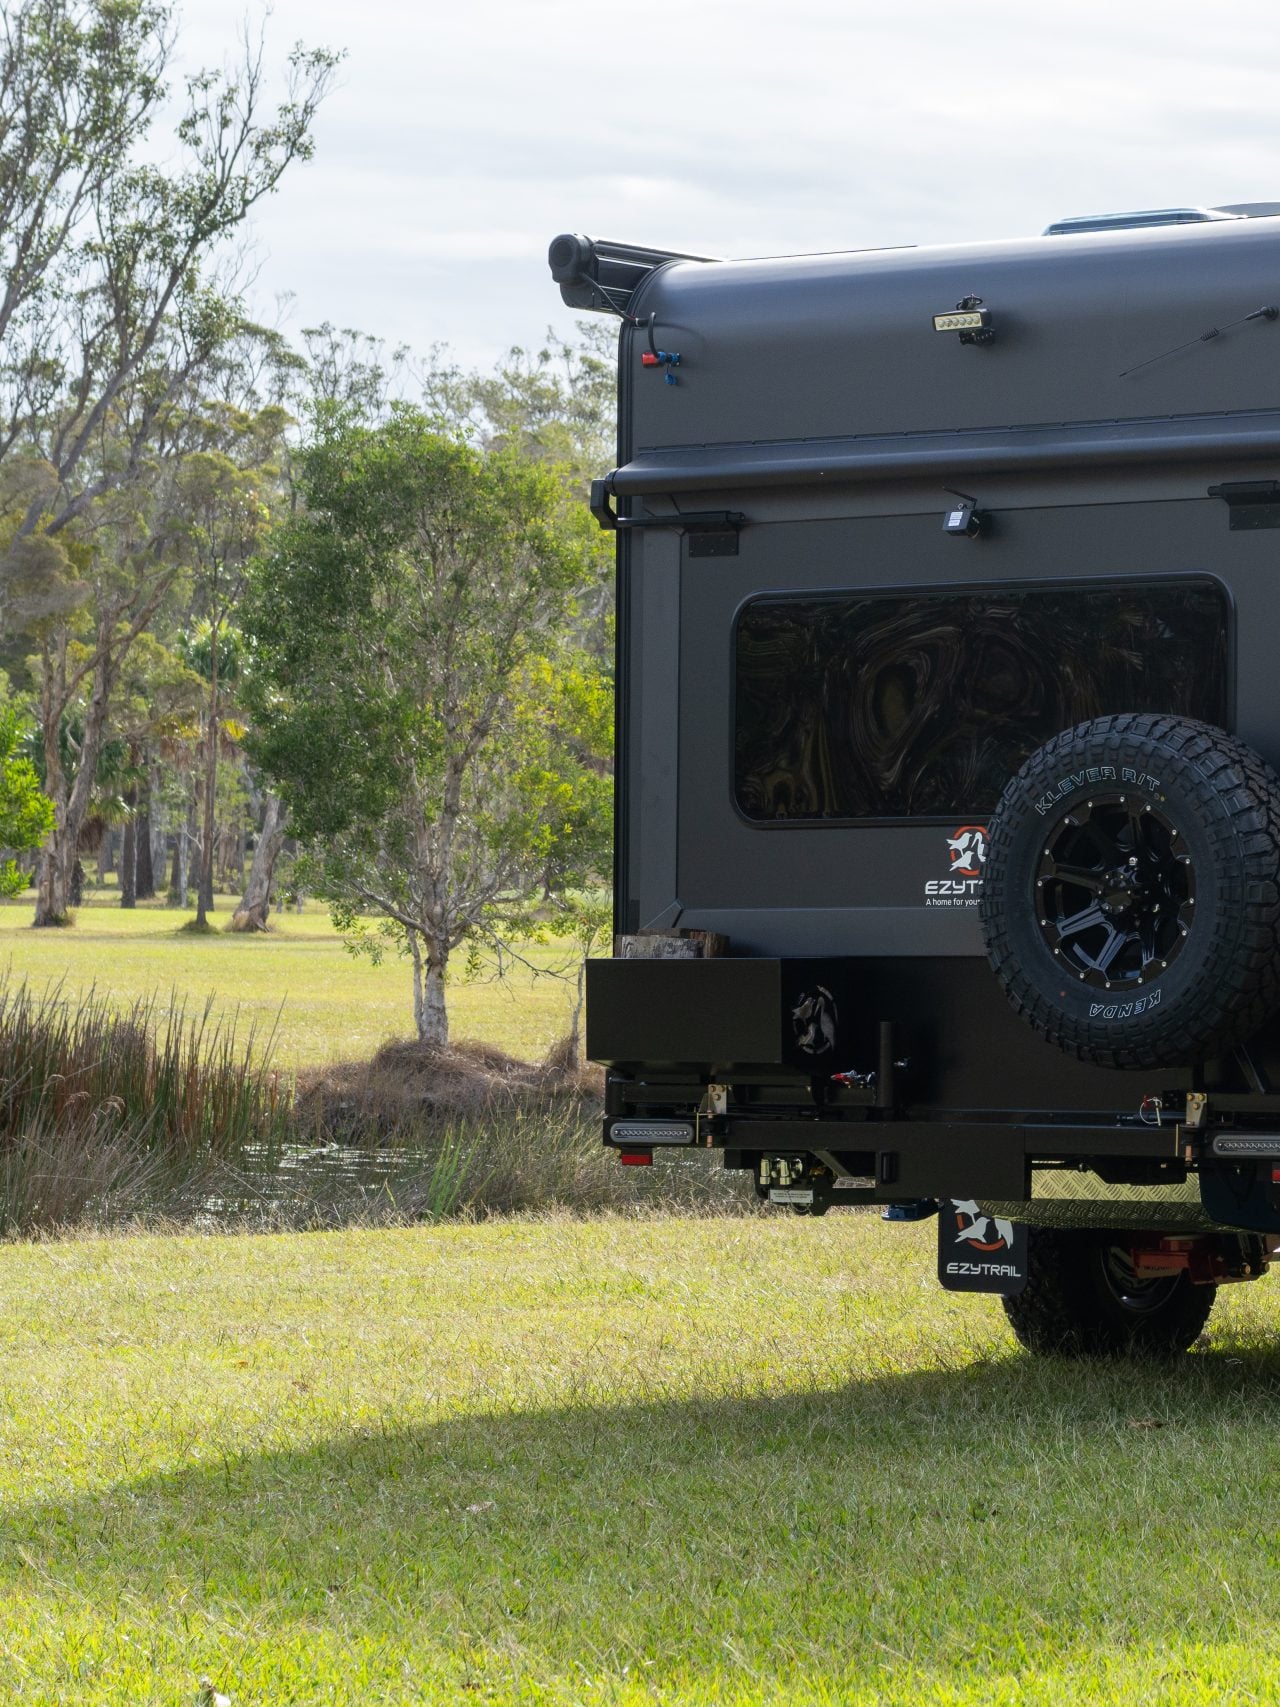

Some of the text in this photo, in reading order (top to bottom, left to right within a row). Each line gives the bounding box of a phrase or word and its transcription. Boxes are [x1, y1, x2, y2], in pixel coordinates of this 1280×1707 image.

[1034, 766, 1117, 815] KLEVER
[925, 880, 984, 894] EZYT
[925, 898, 932, 906] A
[932, 898, 952, 906] home
[953, 898, 963, 906] for
[1089, 989, 1161, 1018] KENDA
[946, 1262, 1022, 1277] EZYTRAIL
